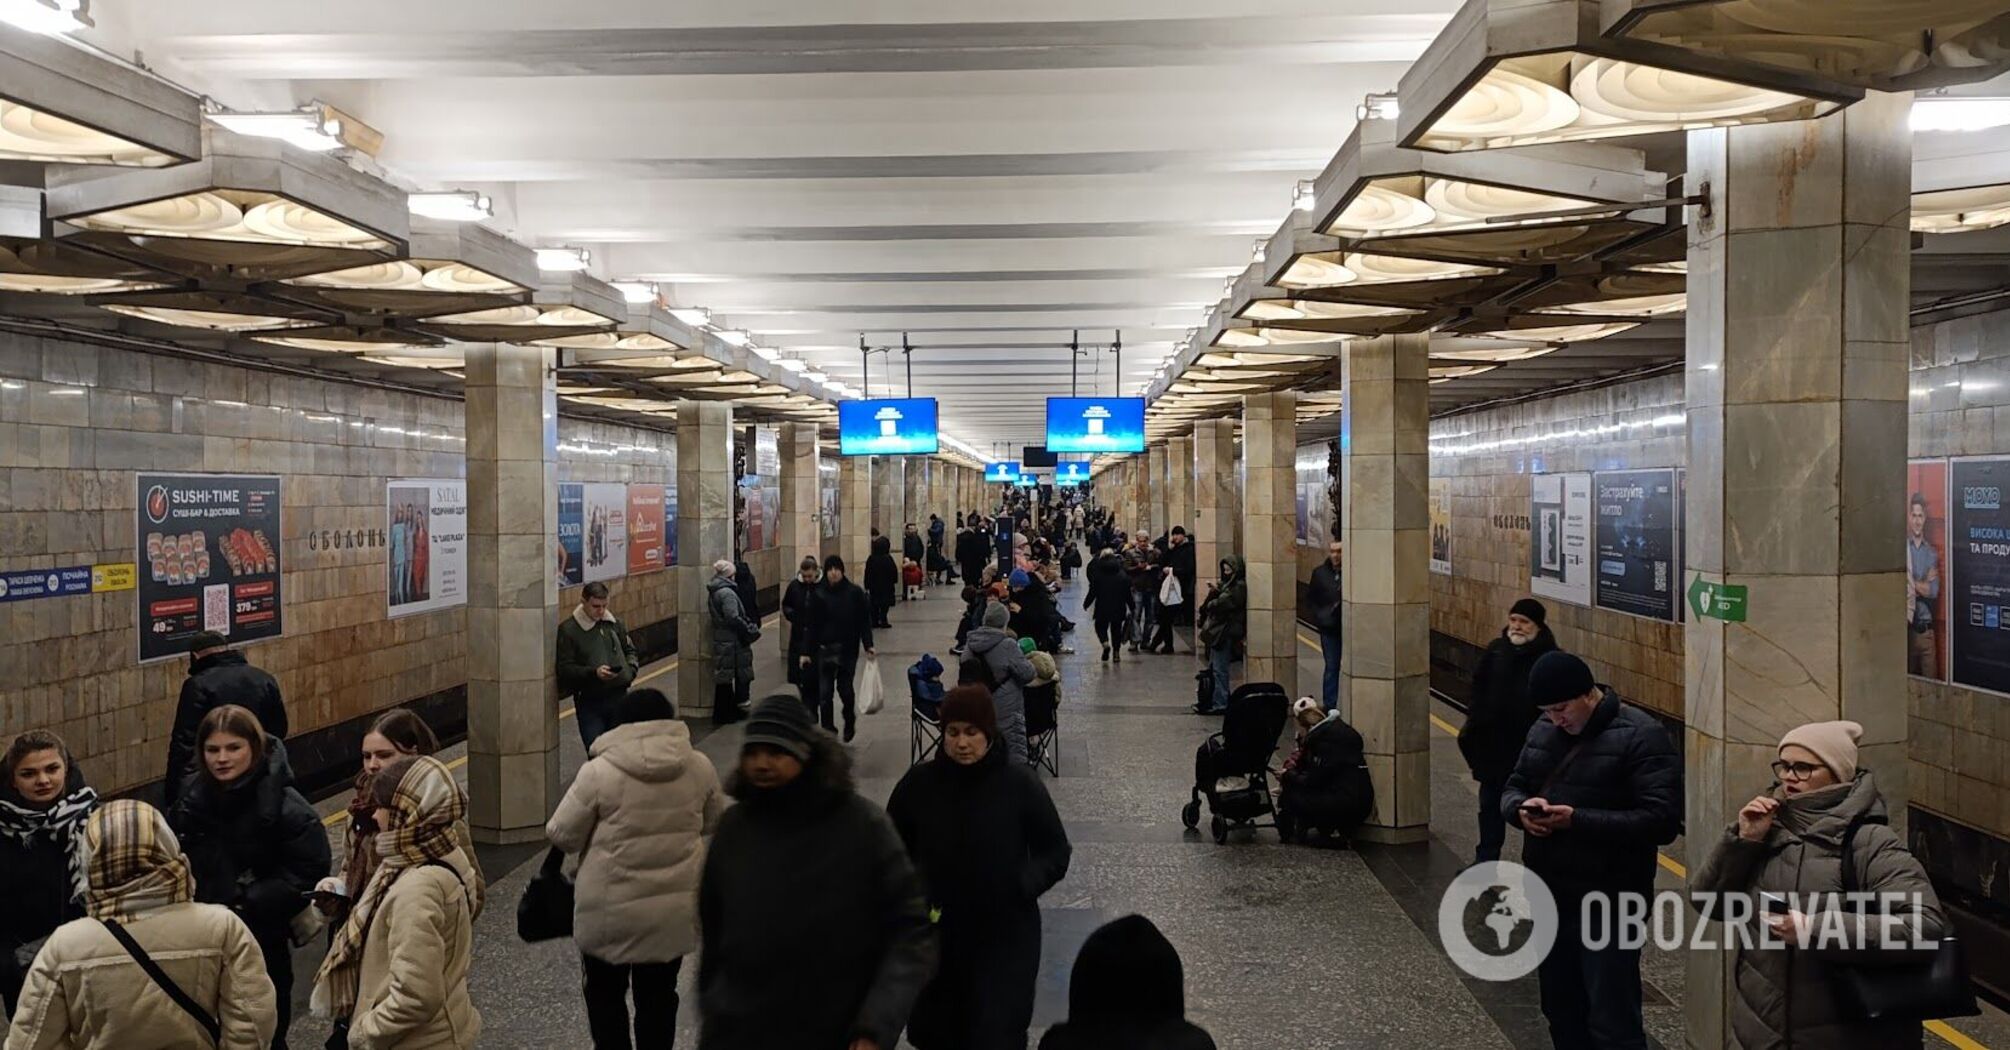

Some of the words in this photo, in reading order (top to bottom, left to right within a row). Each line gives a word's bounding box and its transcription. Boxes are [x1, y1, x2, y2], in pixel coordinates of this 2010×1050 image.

[172, 489, 240, 503] SUSHI-TIME
[1965, 486, 2000, 505] MOYO
[209, 507, 241, 517] ДОСТАВКА
[309, 528, 386, 551] ОБОЛОНЬ
[1970, 528, 2004, 540] ВИСОКА
[1969, 543, 1981, 554] ТА
[236, 602, 251, 613] 379
[153, 622, 166, 633] 49
